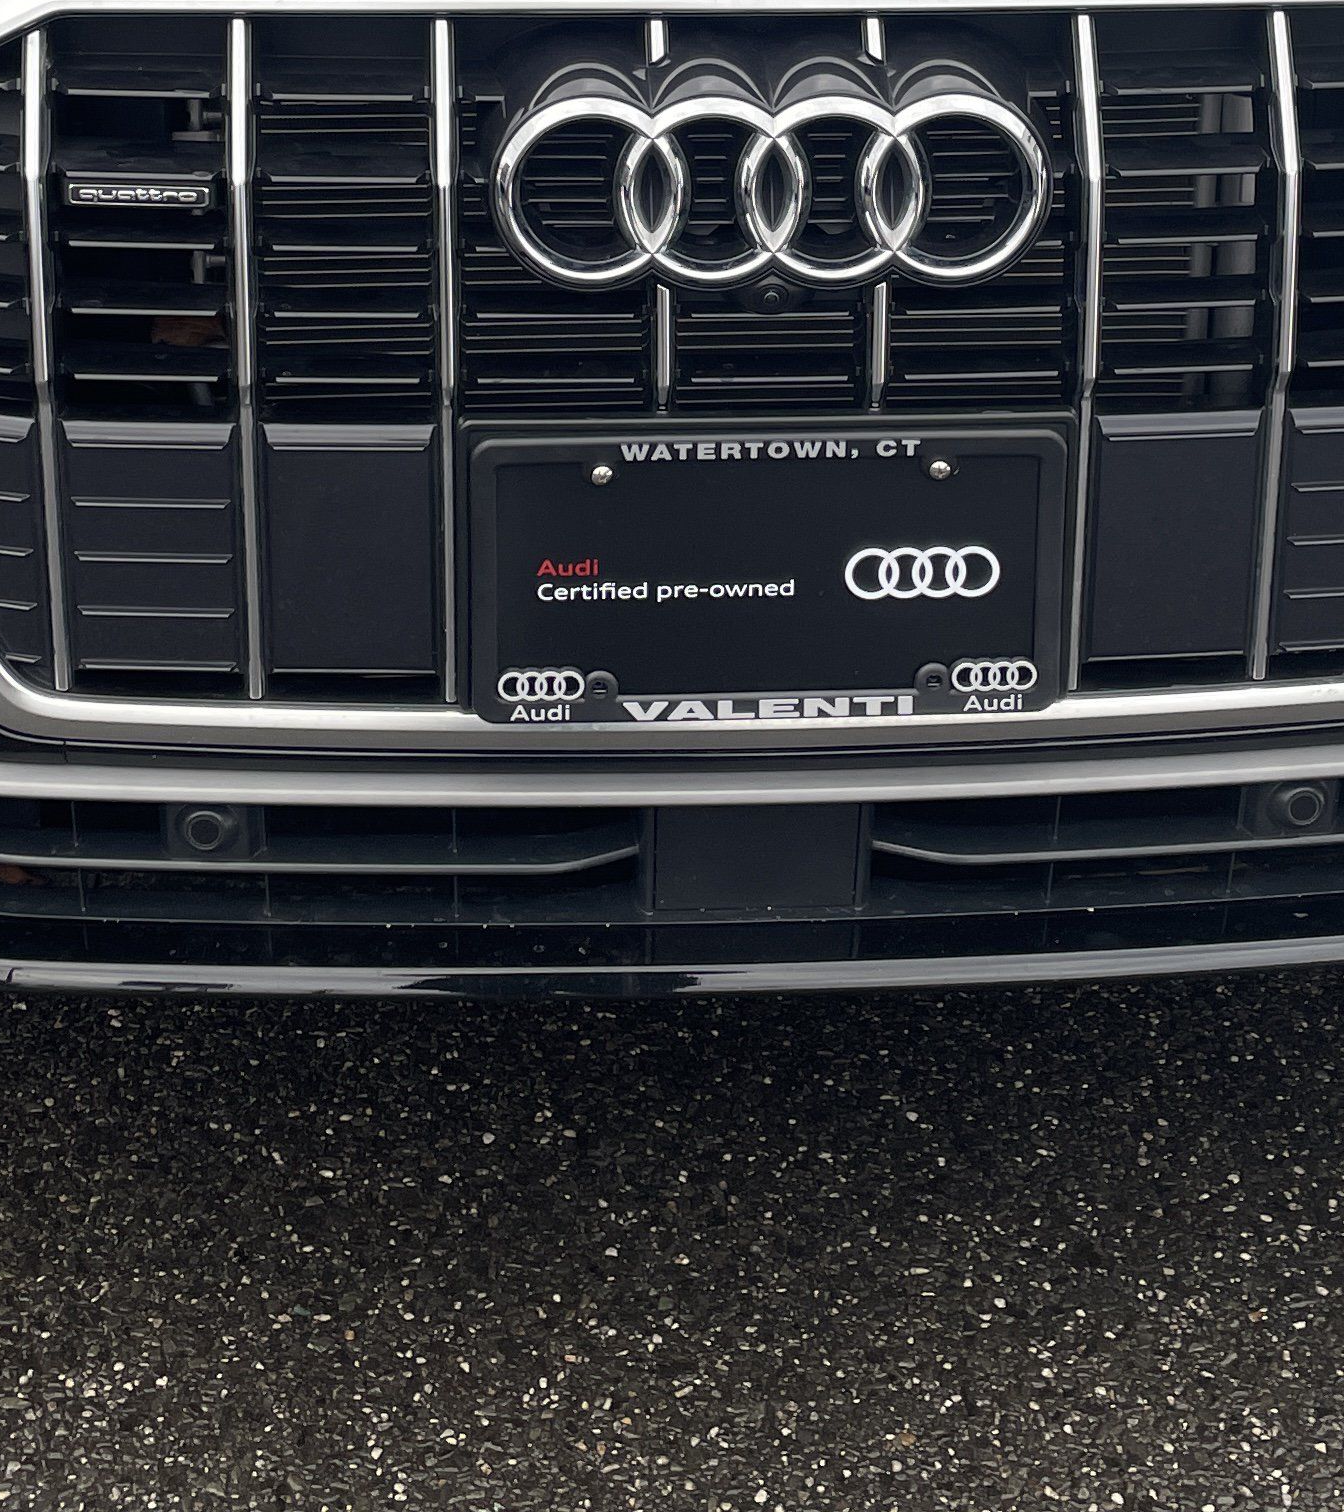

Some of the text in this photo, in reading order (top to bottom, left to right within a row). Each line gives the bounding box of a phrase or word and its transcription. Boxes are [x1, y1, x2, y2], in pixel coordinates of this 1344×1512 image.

[78, 188, 198, 203] quattro
[620, 439, 922, 462] WATERTOWN, CT
[537, 559, 599, 577] Audi
[537, 579, 795, 602] Certified pre-owned
[622, 695, 914, 721] VALENTI
[963, 693, 1024, 712] Audi
[510, 704, 571, 722] Audi
